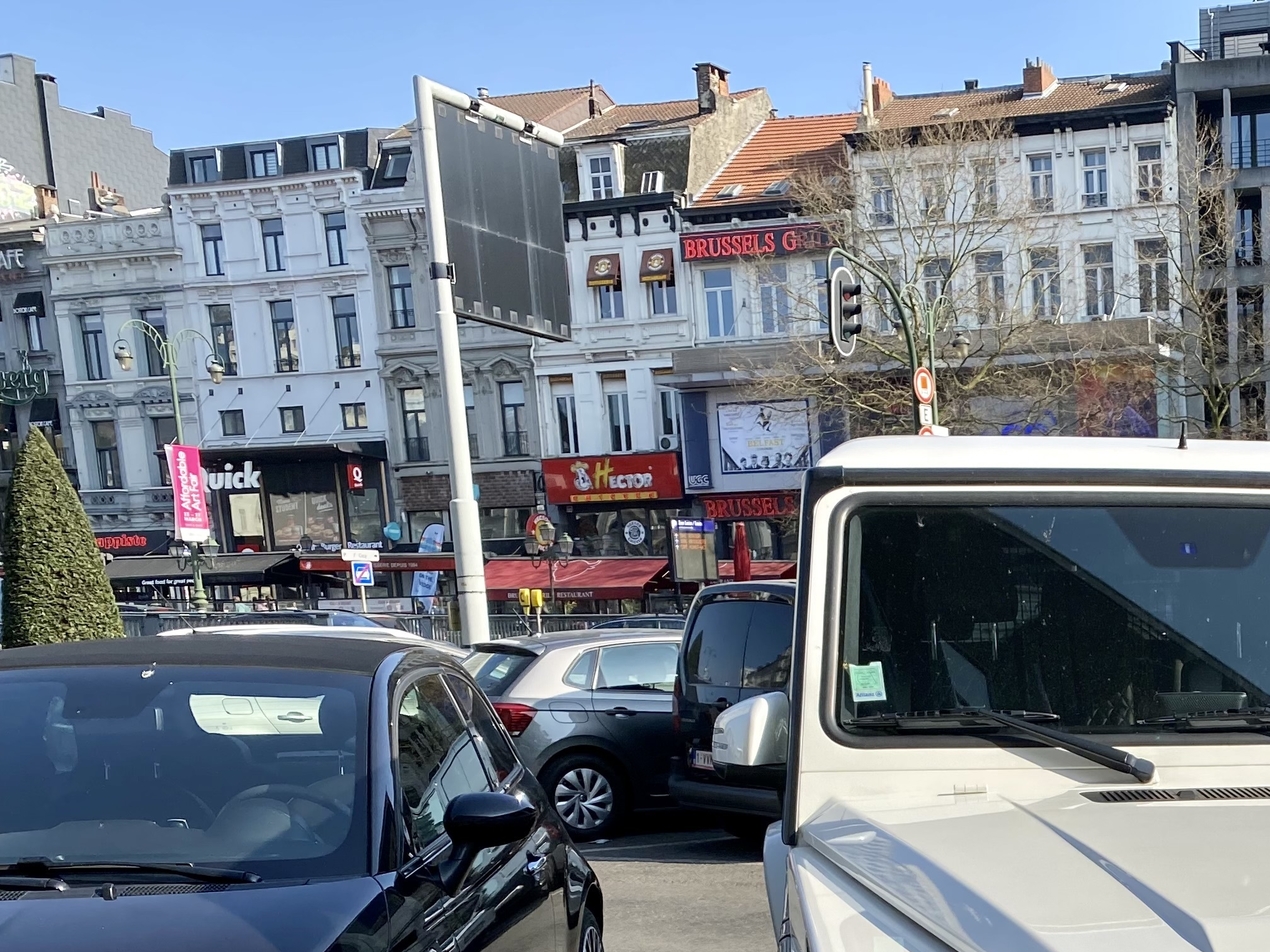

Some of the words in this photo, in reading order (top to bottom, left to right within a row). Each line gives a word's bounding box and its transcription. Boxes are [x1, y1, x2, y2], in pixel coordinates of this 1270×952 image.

[683, 231, 775, 260] BRUSSELS
[747, 438, 785, 448] BELFAST
[176, 450, 190, 511] Affordable
[594, 457, 653, 490] HECTOR
[688, 474, 710, 486] UGC
[703, 496, 796, 518] BRUSSELS
[94, 534, 147, 549] appiste
[347, 540, 384, 550] Restaurant
